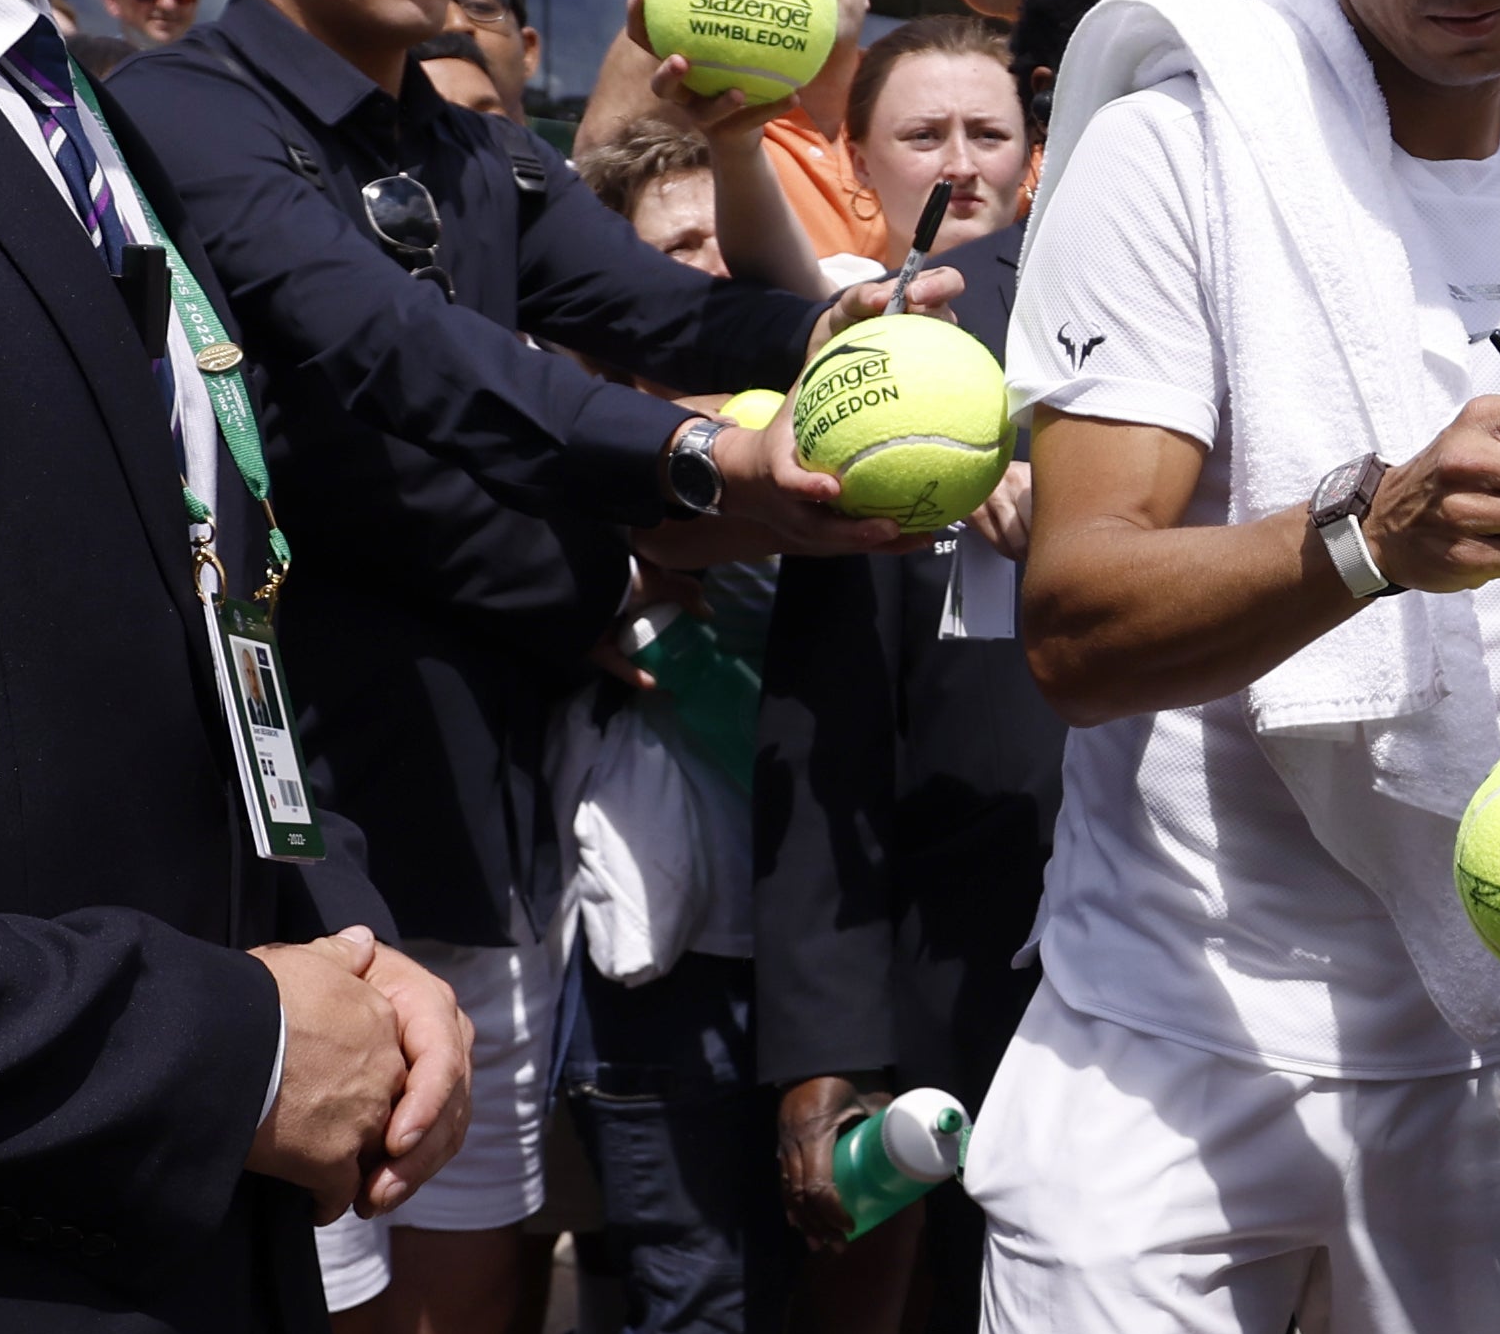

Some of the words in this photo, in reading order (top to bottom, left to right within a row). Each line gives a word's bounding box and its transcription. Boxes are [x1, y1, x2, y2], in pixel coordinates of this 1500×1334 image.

[689, 18, 808, 53] WIMBLEDON
[184, 301, 216, 345] 2022
[801, 384, 900, 461] WIMBLEDON
